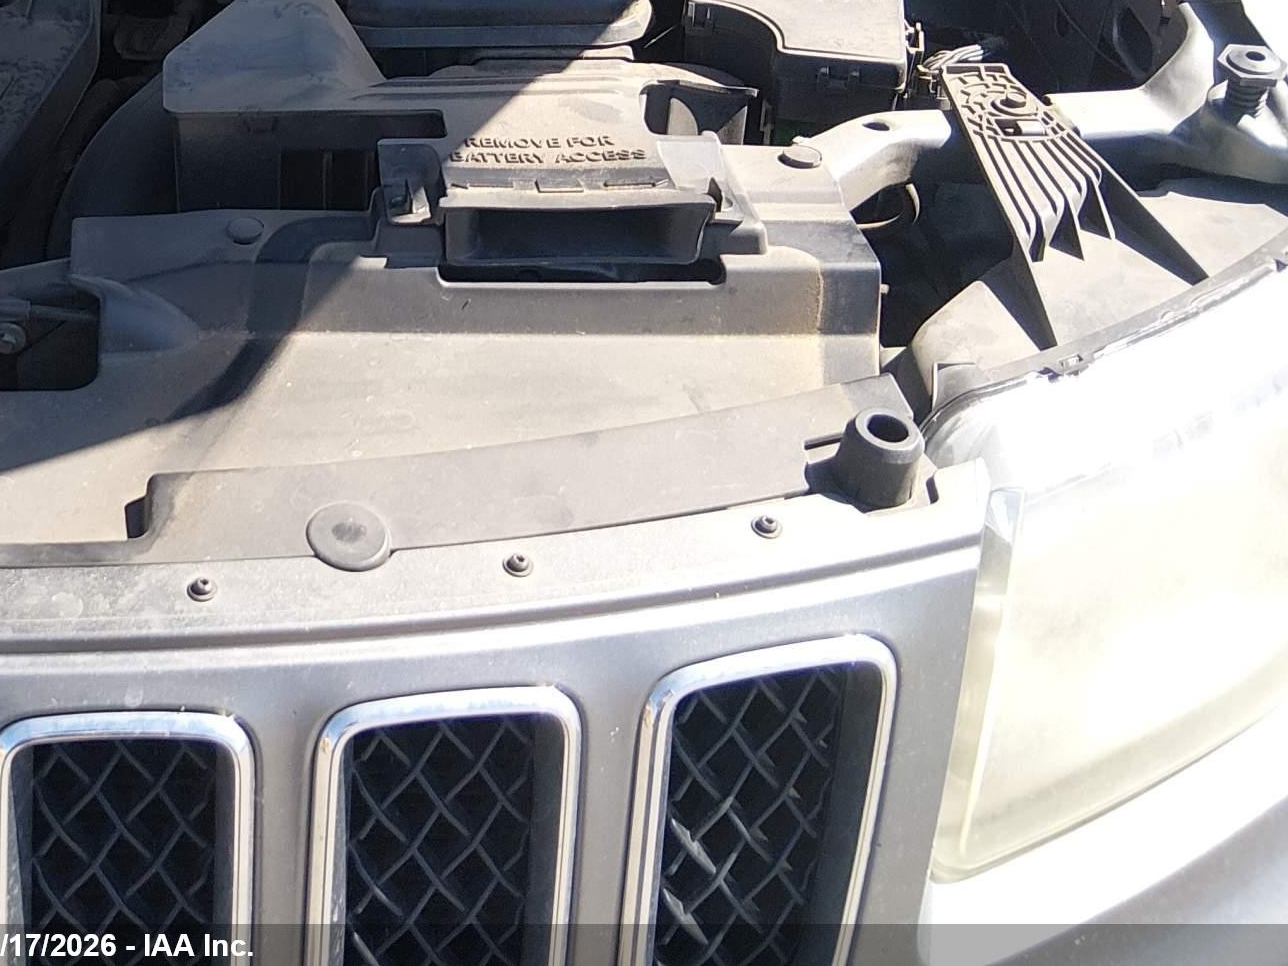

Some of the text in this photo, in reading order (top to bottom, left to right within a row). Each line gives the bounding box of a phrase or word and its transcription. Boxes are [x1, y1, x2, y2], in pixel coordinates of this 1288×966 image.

[464, 135, 616, 149] REMOVE FOR
[449, 149, 647, 164] BATTERY ACCESS
